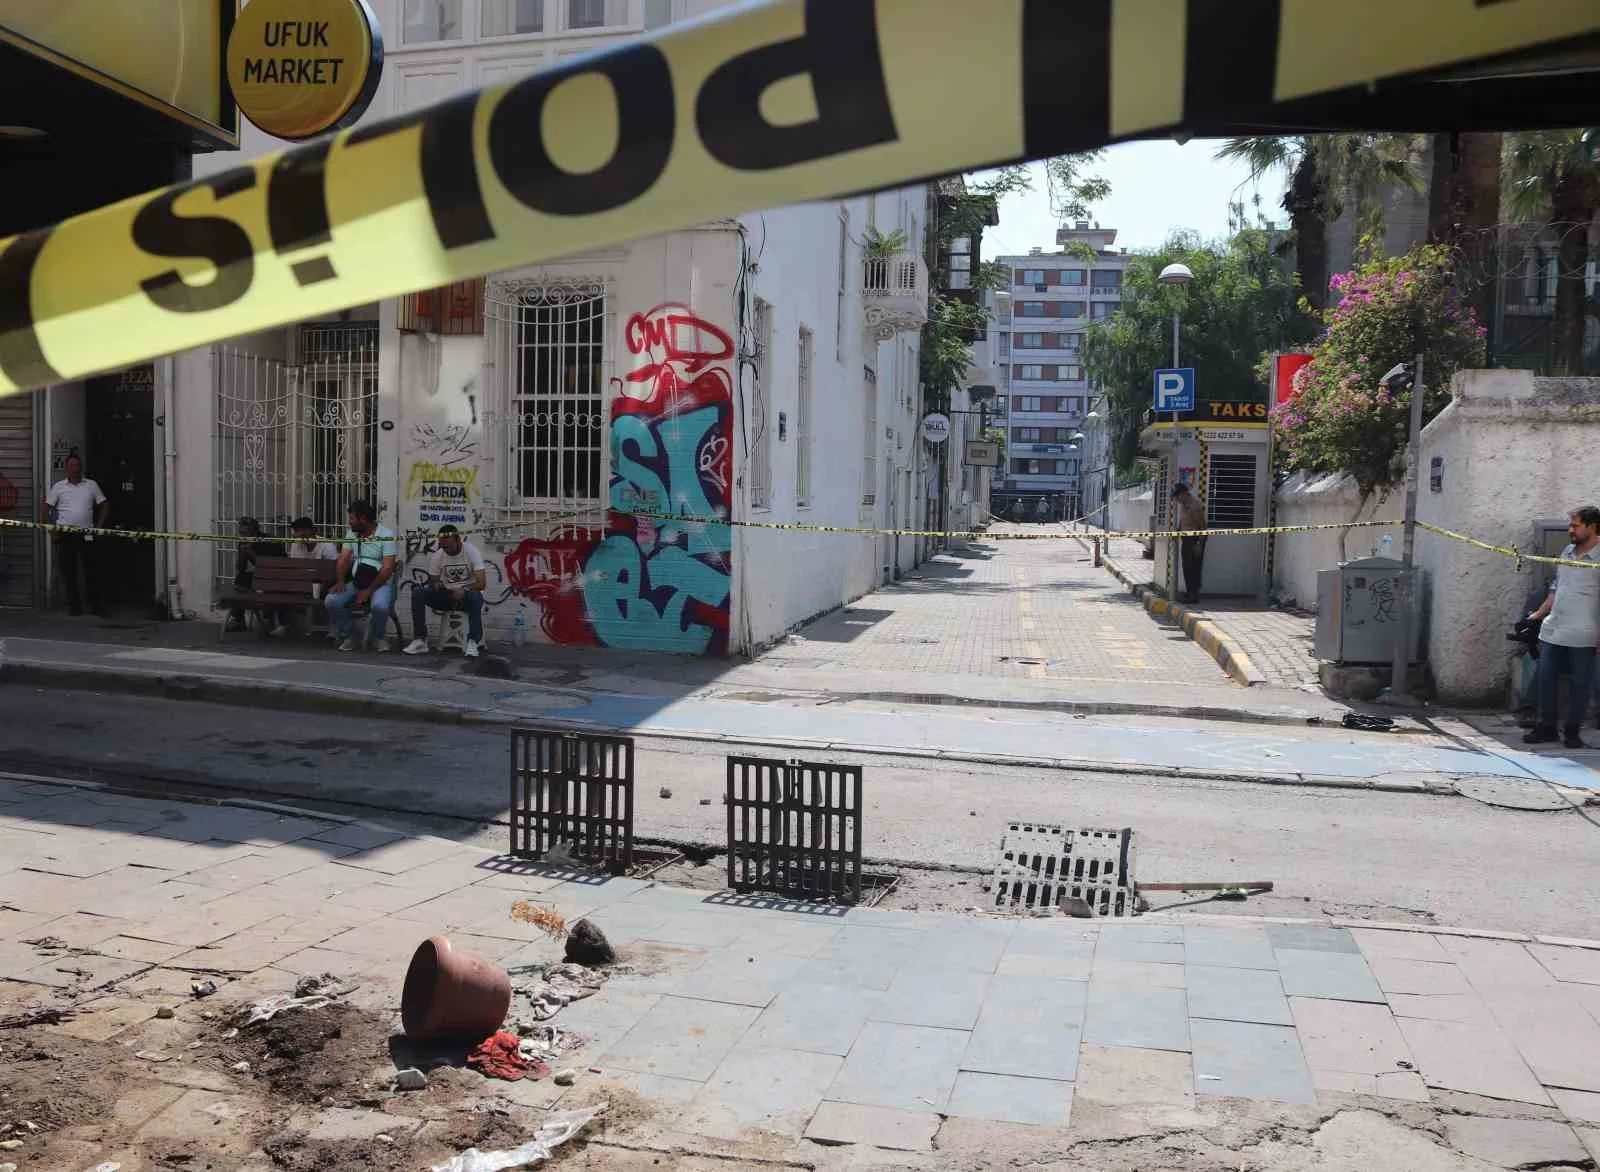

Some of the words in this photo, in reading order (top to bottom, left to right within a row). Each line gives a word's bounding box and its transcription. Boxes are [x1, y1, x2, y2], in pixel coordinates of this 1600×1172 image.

[263, 21, 329, 48] UFUK
[243, 57, 344, 85] MARKET
[1158, 373, 1185, 408] P
[422, 485, 466, 498] MURDA
